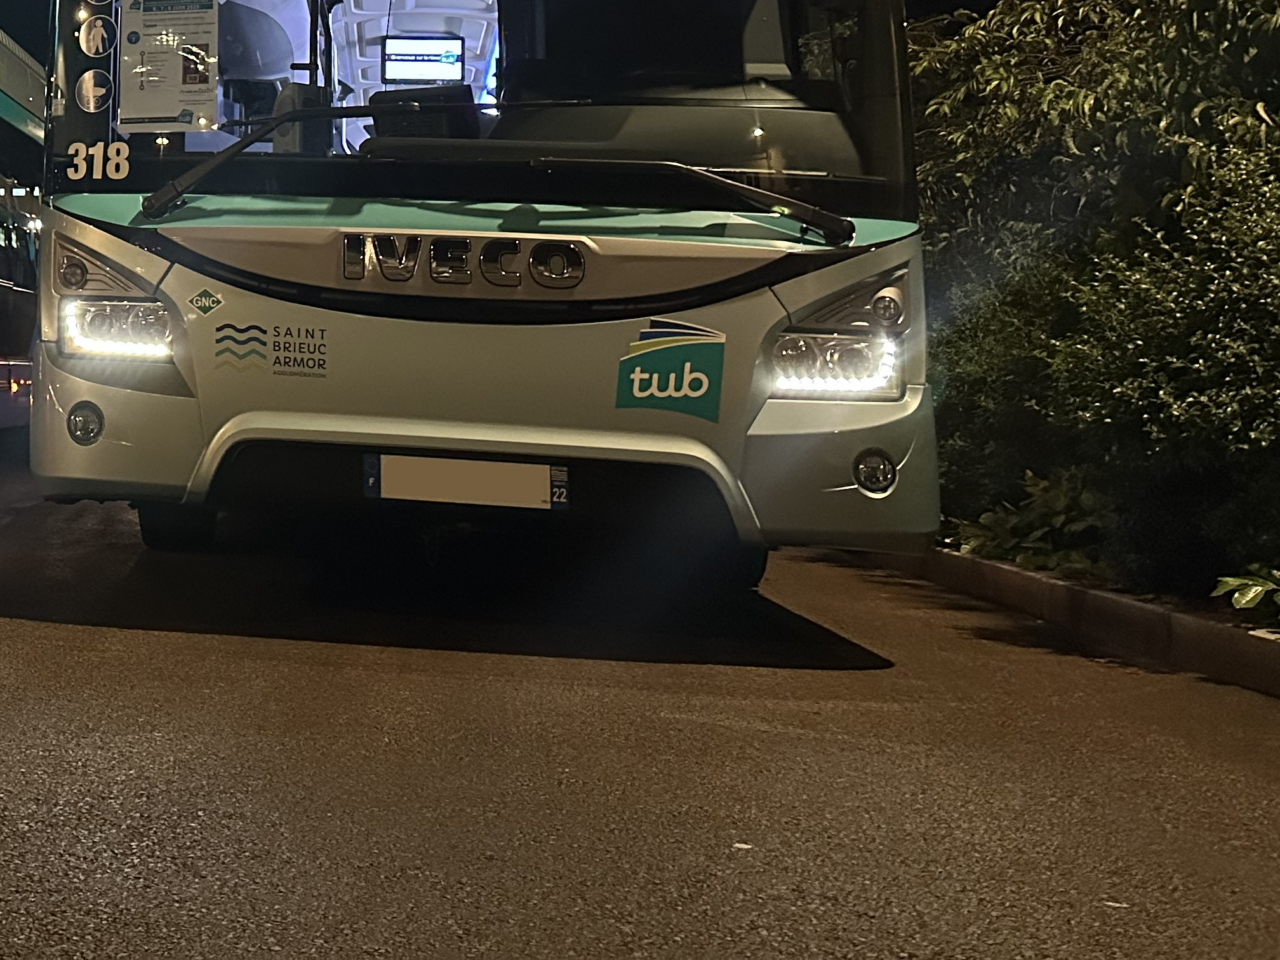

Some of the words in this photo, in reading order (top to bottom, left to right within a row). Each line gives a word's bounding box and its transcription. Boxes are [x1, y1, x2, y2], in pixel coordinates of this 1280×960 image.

[66, 141, 130, 180] 318
[342, 234, 587, 289] IVECO
[192, 296, 219, 308] GNC
[272, 326, 327, 340] SAINT
[272, 341, 327, 355] BRIEUC
[272, 355, 327, 370] ARMOR
[629, 362, 710, 399] tub
[552, 487, 568, 502] 22
